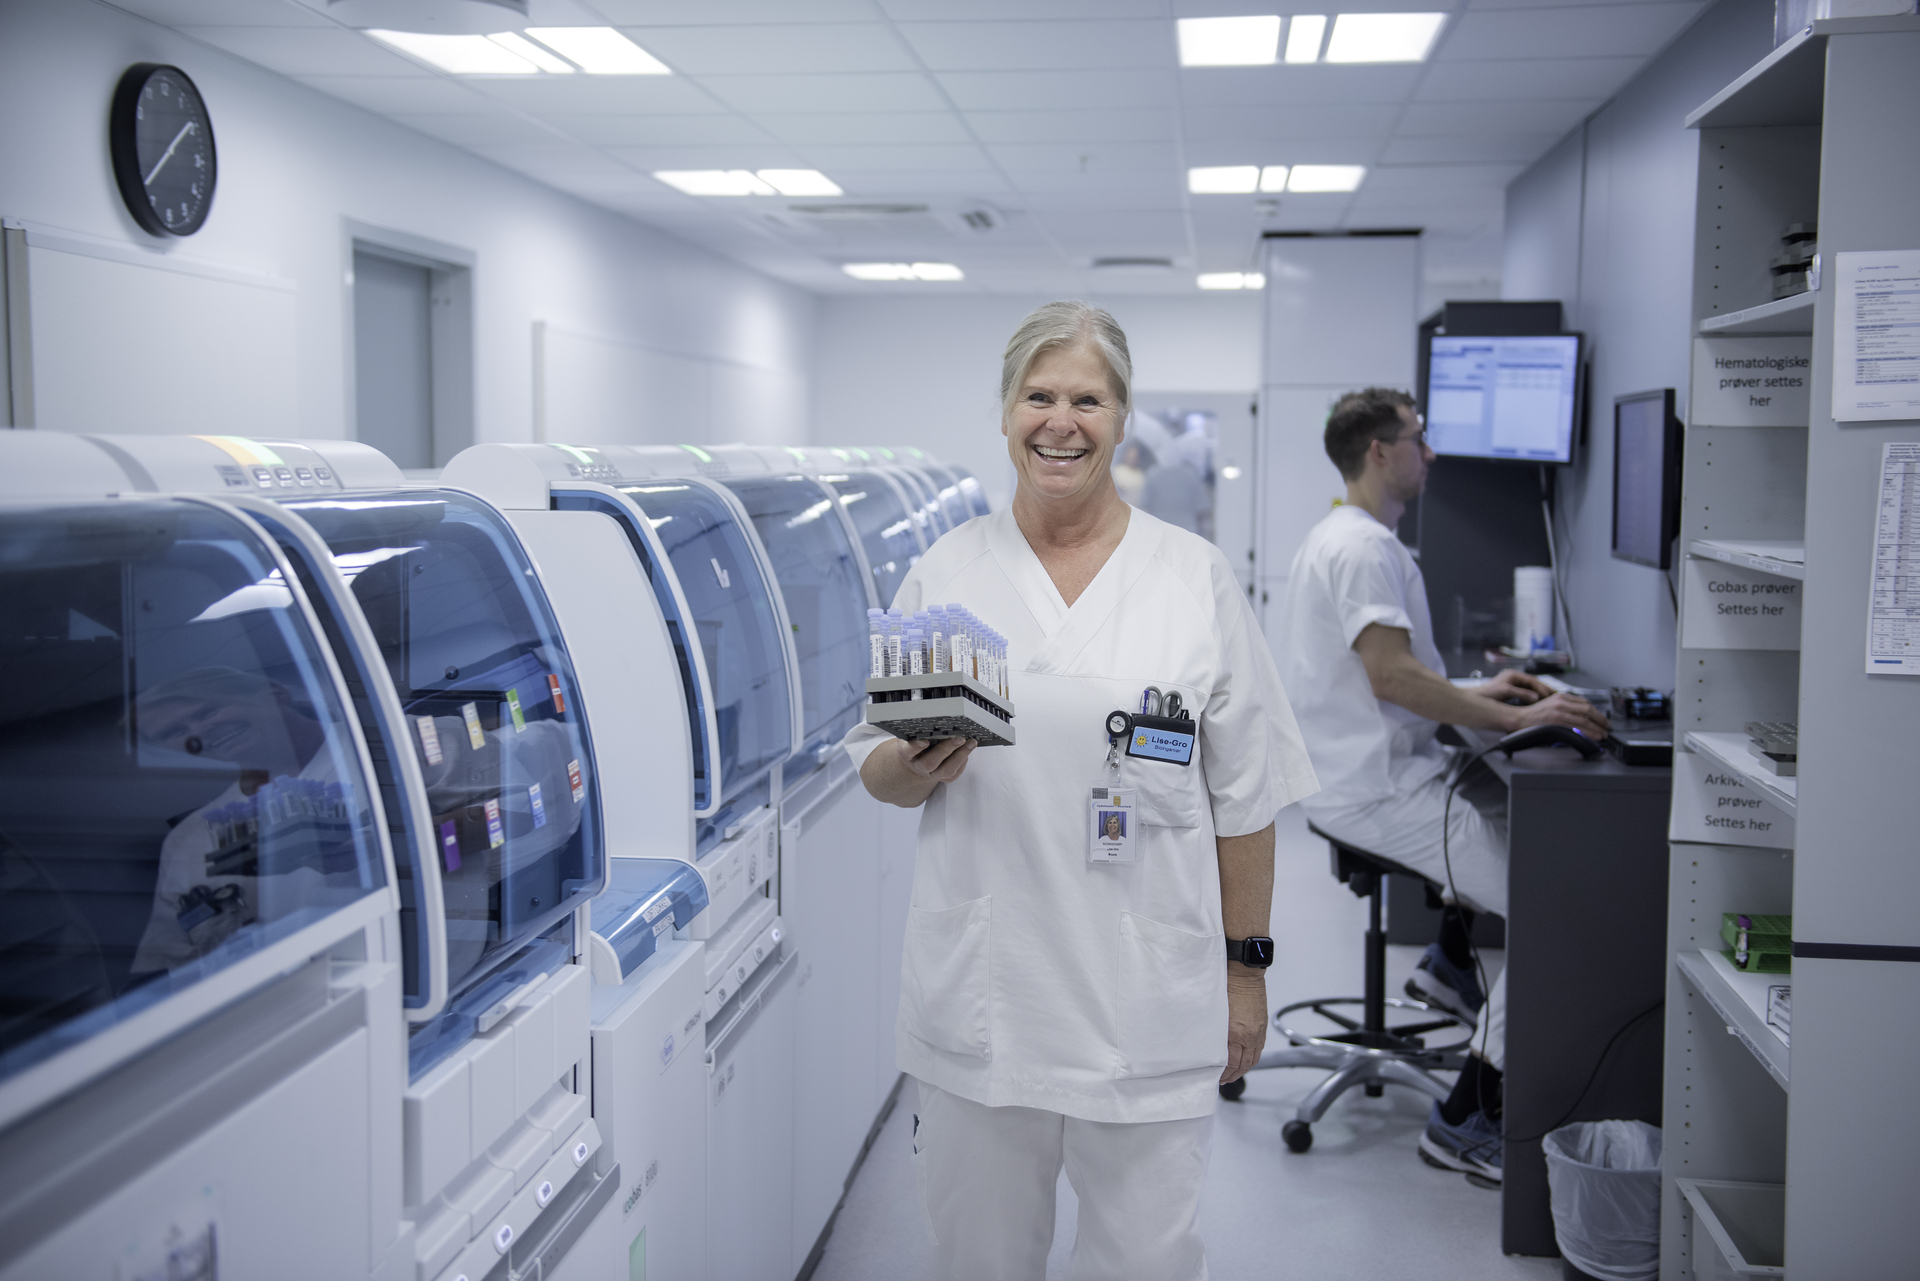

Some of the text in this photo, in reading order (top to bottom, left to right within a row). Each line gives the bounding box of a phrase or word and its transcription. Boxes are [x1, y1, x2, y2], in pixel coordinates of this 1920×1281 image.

[1715, 356, 1809, 370] Hematologiske
[1719, 377, 1803, 390] prøver settes
[1749, 395, 1771, 406] her
[1708, 581, 1796, 595] Cobas prøver
[1717, 603, 1785, 615] Settes her
[1151, 736, 1188, 748] Lise-Gro
[1705, 774, 1745, 788] Arkiv
[1718, 797, 1762, 808] prøver
[1705, 815, 1772, 831] Settes her
